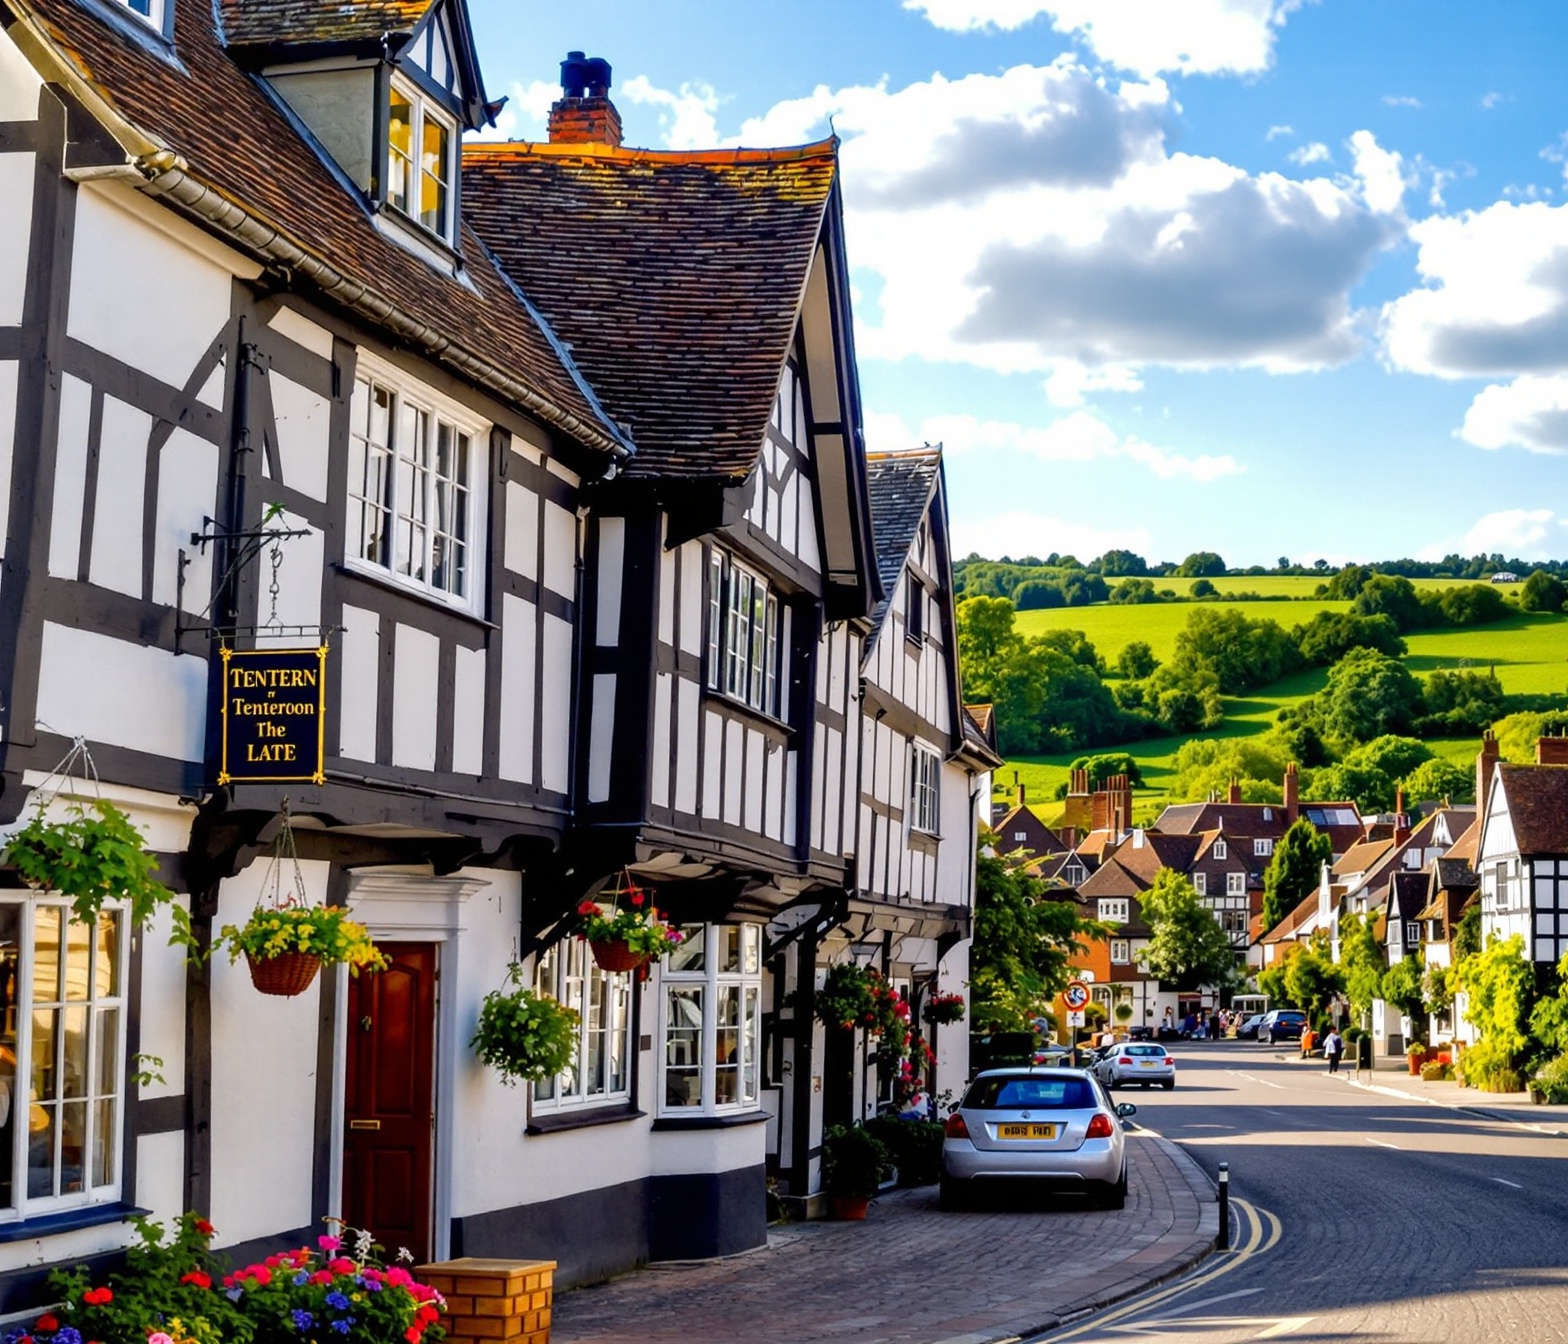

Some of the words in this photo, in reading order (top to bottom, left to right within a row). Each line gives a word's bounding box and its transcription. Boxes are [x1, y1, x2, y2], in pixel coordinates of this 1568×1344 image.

[231, 669, 316, 688] TENTERN
[232, 699, 315, 716] Tenteroon
[257, 722, 287, 737] The
[248, 744, 297, 761] LATE
